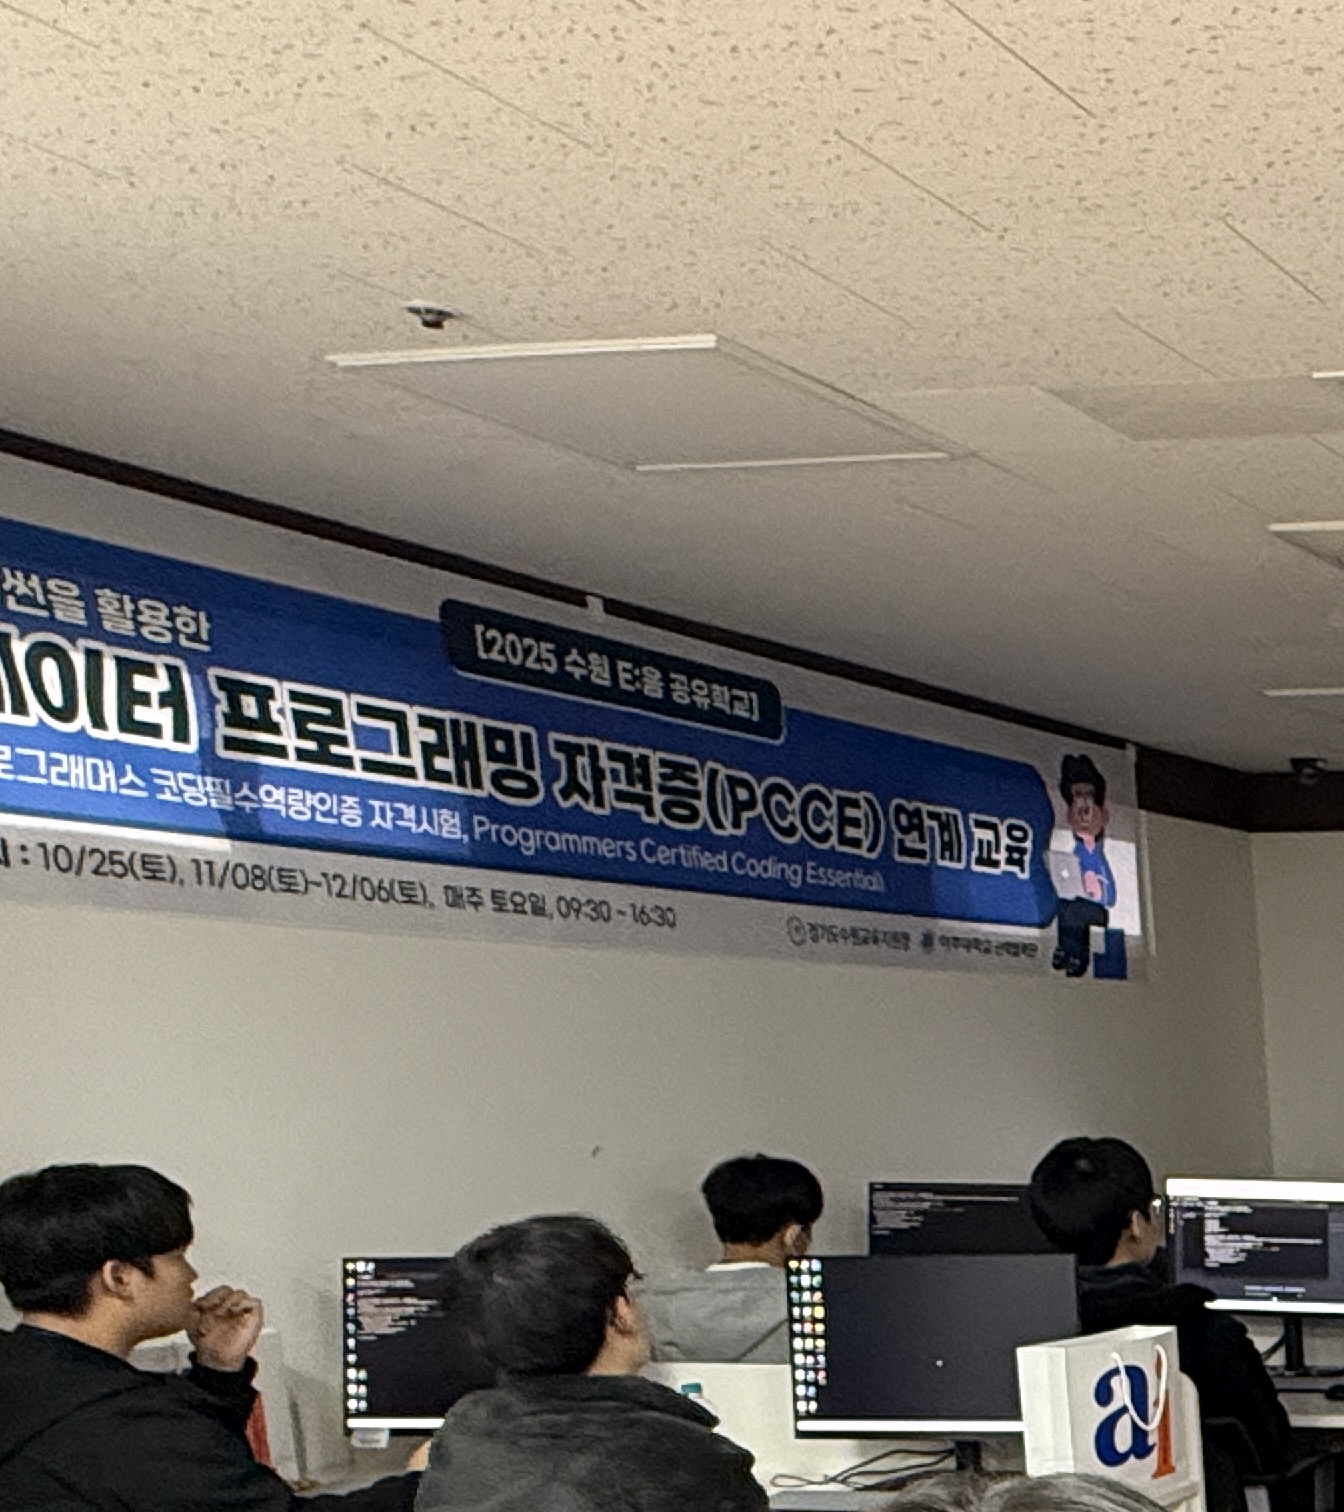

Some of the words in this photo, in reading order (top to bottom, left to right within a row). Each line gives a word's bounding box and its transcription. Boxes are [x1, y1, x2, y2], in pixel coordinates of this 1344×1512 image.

[95, 587, 212, 651] 활용한
[564, 648, 612, 687] 수원
[208, 667, 544, 806] 프로그래밍
[549, 732, 885, 859] 자격증(PCCE)
[889, 797, 967, 870] 연계
[969, 813, 1033, 880] 교육
[150, 767, 362, 828] 코딩필수역량인증
[368, 799, 470, 844] 자격시험,
[472, 813, 638, 862] Programmers
[641, 837, 728, 873] Certified
[731, 850, 803, 889] Coding
